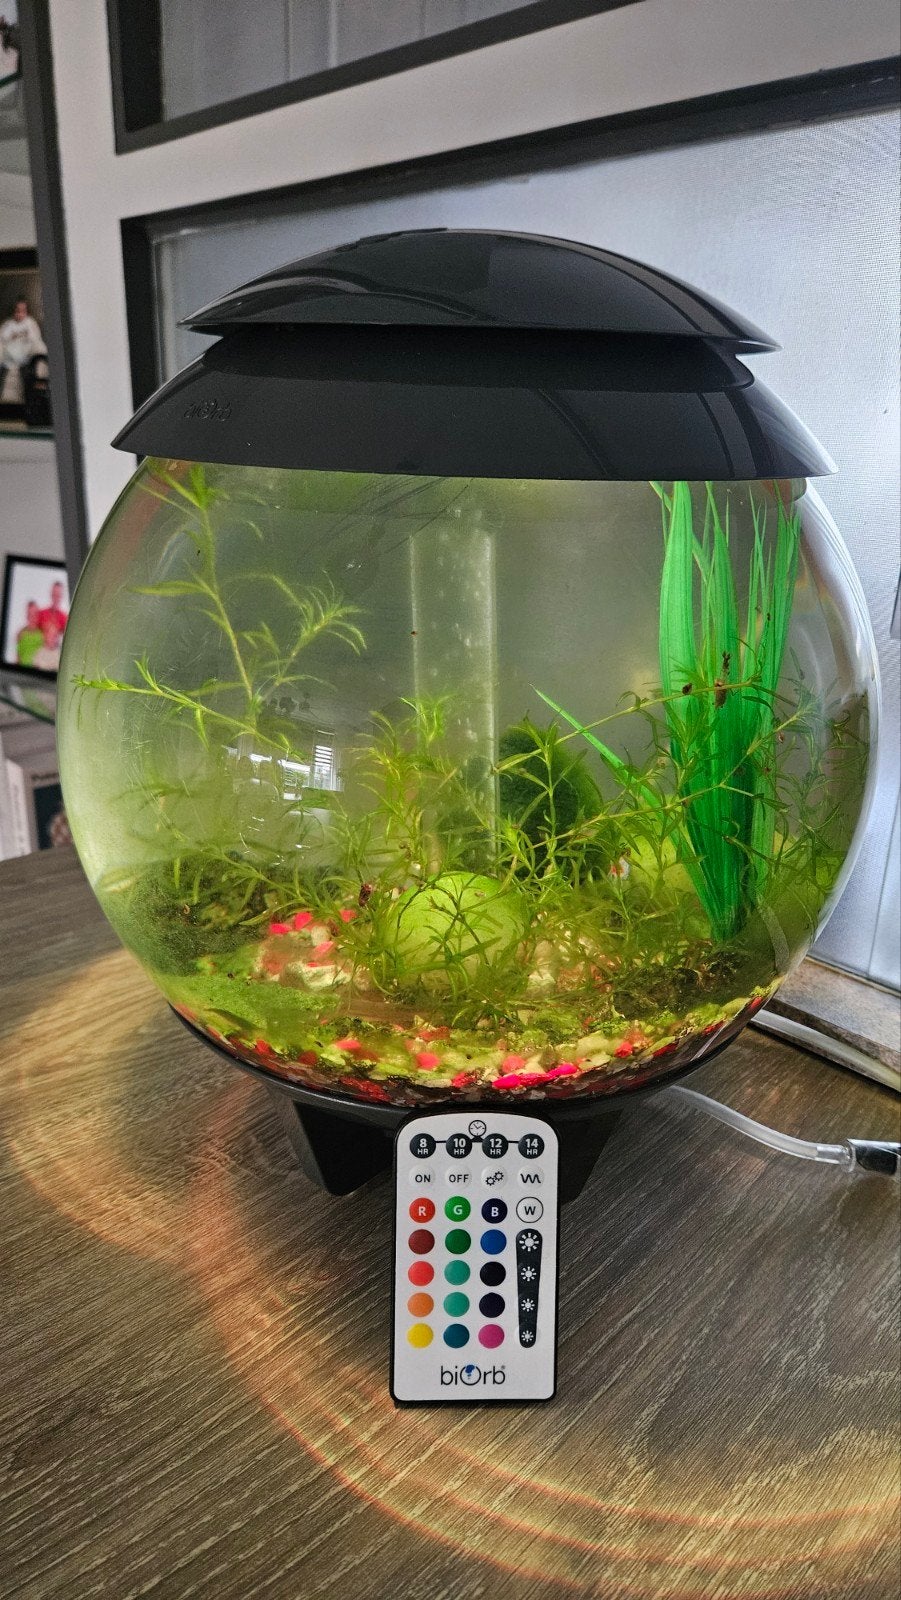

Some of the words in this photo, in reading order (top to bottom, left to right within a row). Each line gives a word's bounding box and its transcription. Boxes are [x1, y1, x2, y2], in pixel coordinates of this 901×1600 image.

[419, 1138, 428, 1148] 8
[453, 1138, 466, 1148] 10
[489, 1138, 503, 1148] 12
[525, 1138, 539, 1148] 14
[415, 1174, 431, 1183] ON
[449, 1174, 469, 1183] OFF
[418, 1206, 427, 1216] R
[453, 1205, 463, 1215] G
[491, 1206, 499, 1217] B
[524, 1206, 536, 1216] W
[440, 1364, 506, 1386] biOrb
